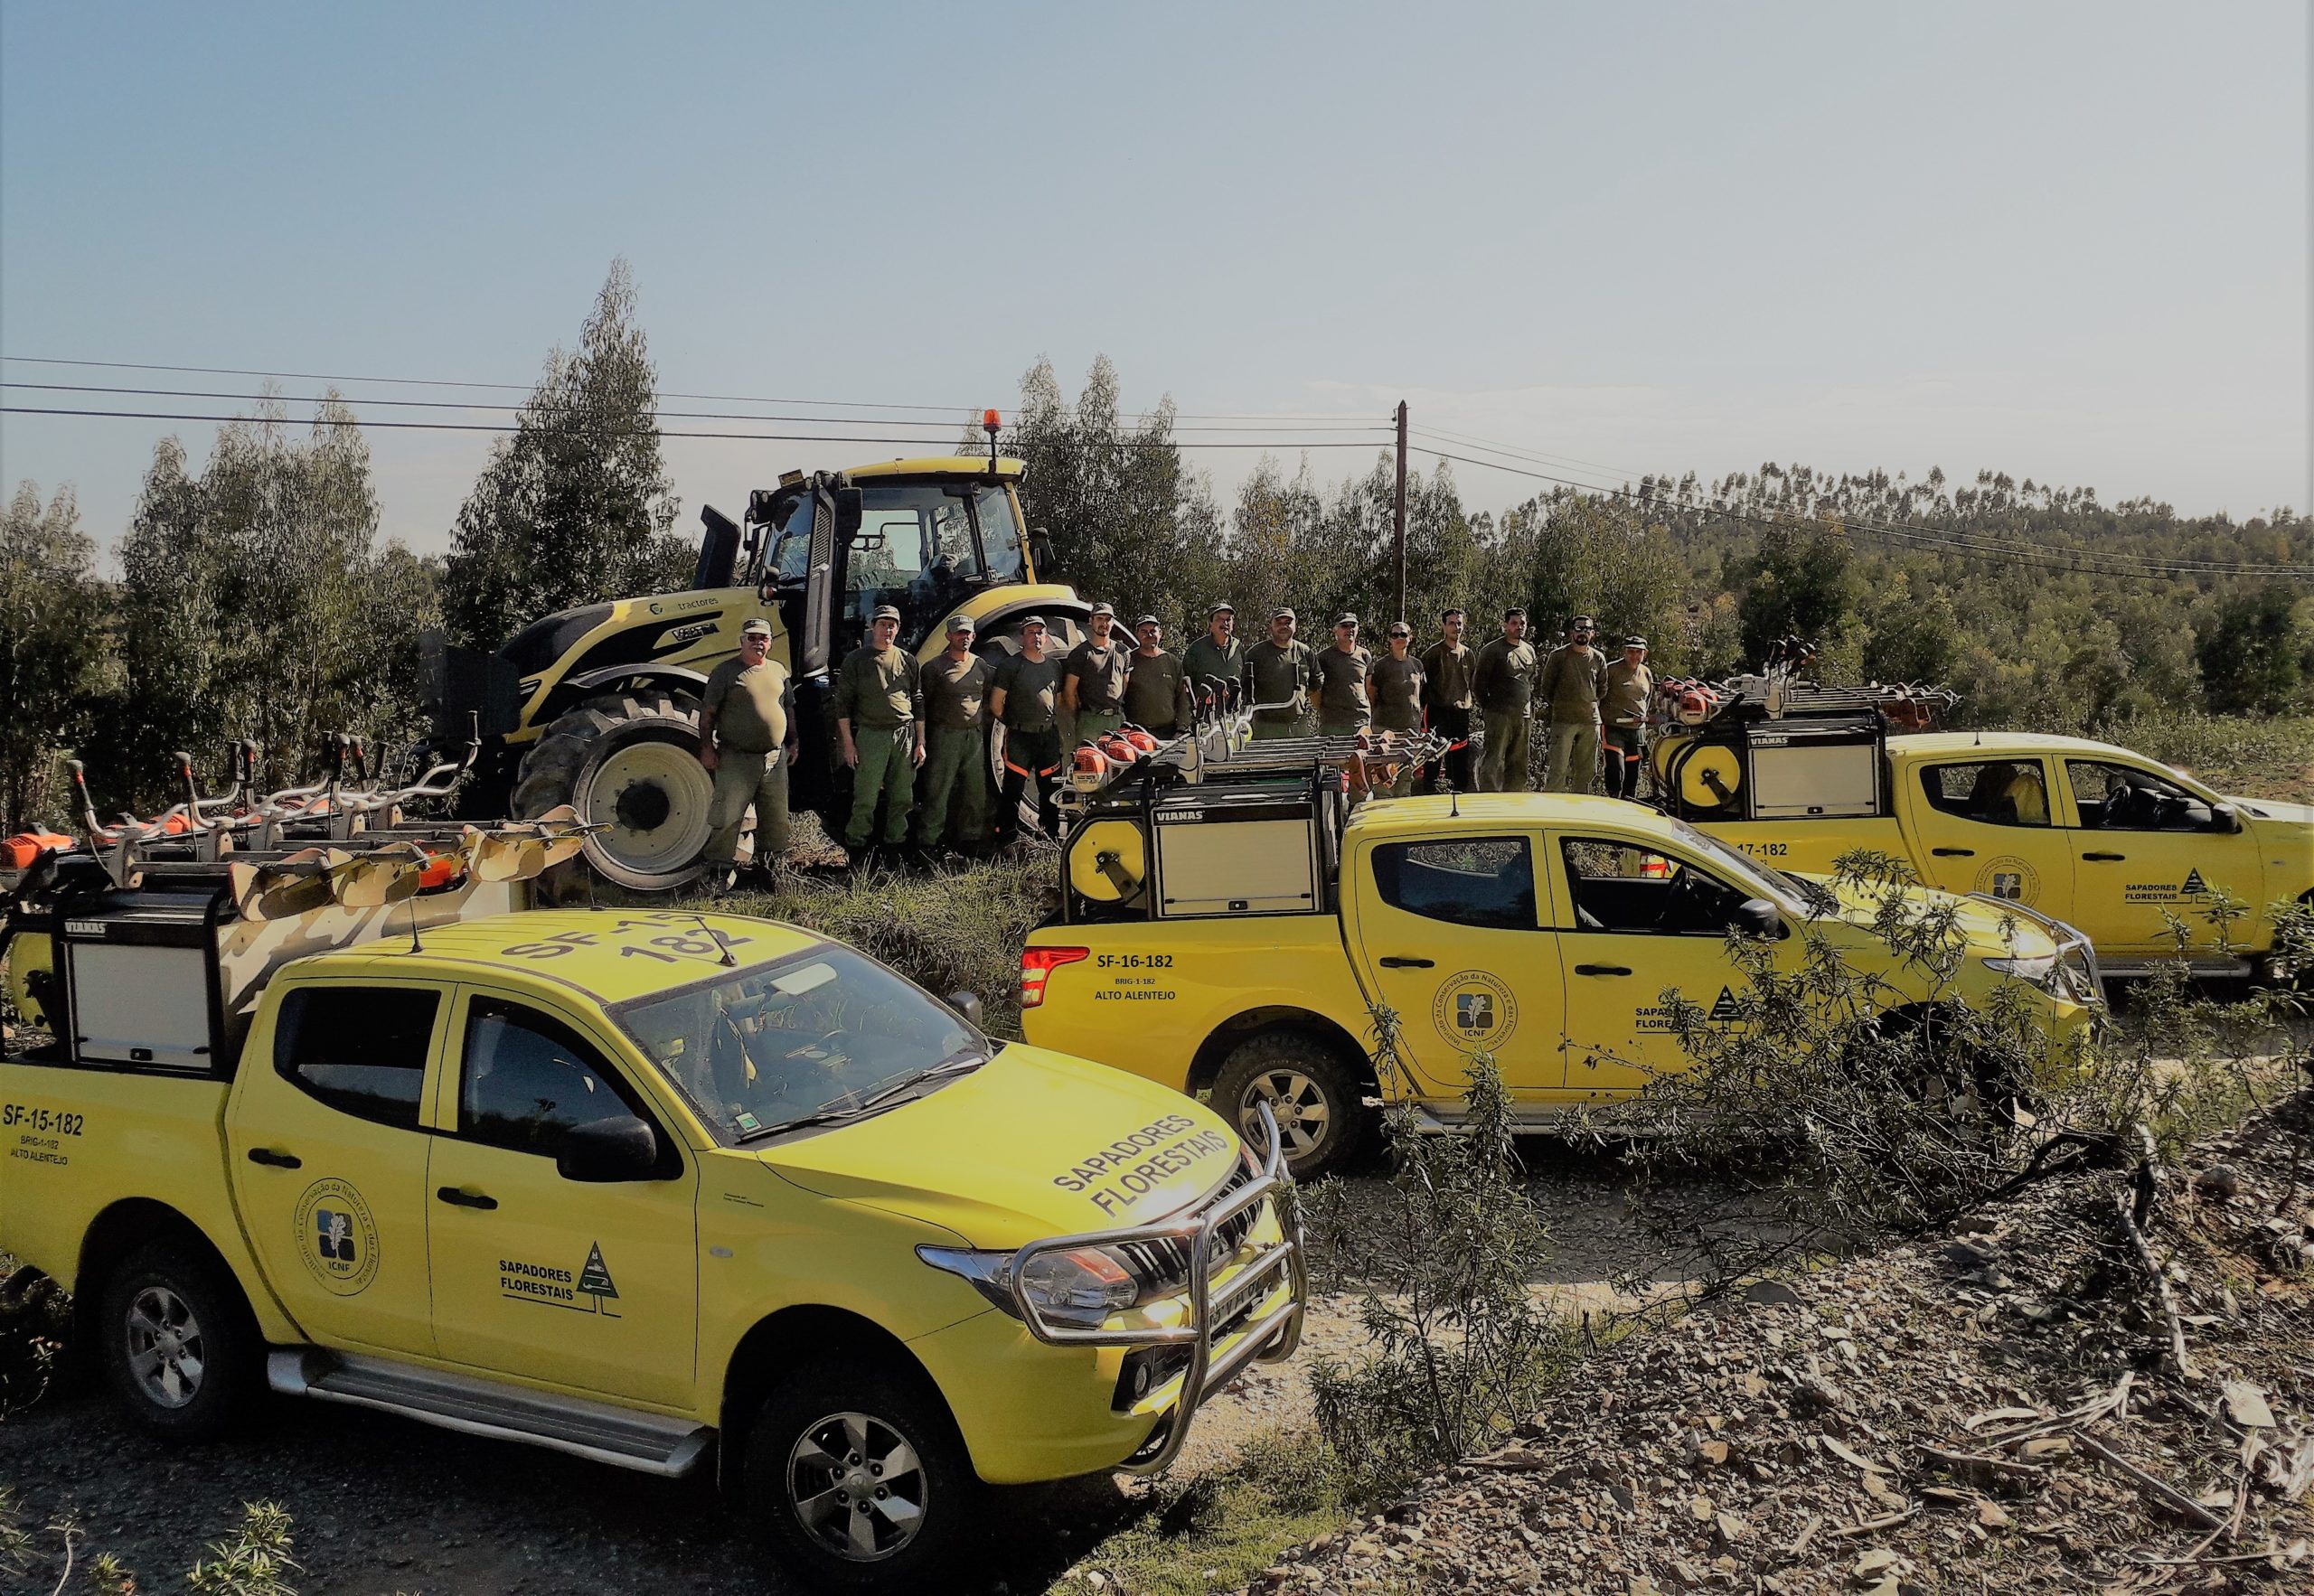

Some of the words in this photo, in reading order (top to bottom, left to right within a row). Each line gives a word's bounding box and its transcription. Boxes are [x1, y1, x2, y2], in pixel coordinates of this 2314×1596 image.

[678, 597, 719, 610] tractores
[1750, 737, 1790, 745] VIANAS
[1157, 810, 1203, 821] VIANAS
[619, 928, 754, 963] 182
[1096, 954, 1173, 968] SF-16-182
[1095, 990, 1122, 1000] ALTO
[1124, 990, 1176, 1000] ALENTEJO
[1435, 973, 1469, 1008] Conservação
[1482, 974, 1509, 999] Natureza
[3, 1103, 84, 1136] SF-15-182
[11, 1148, 29, 1159] ALTO
[1053, 1114, 1195, 1192] SAPADORES
[1090, 1130, 1228, 1218] FLORESTAIS
[328, 1261, 351, 1272] ICNF
[499, 1260, 572, 1283] SAPADORES
[500, 1277, 574, 1300] FLORESTAIS
